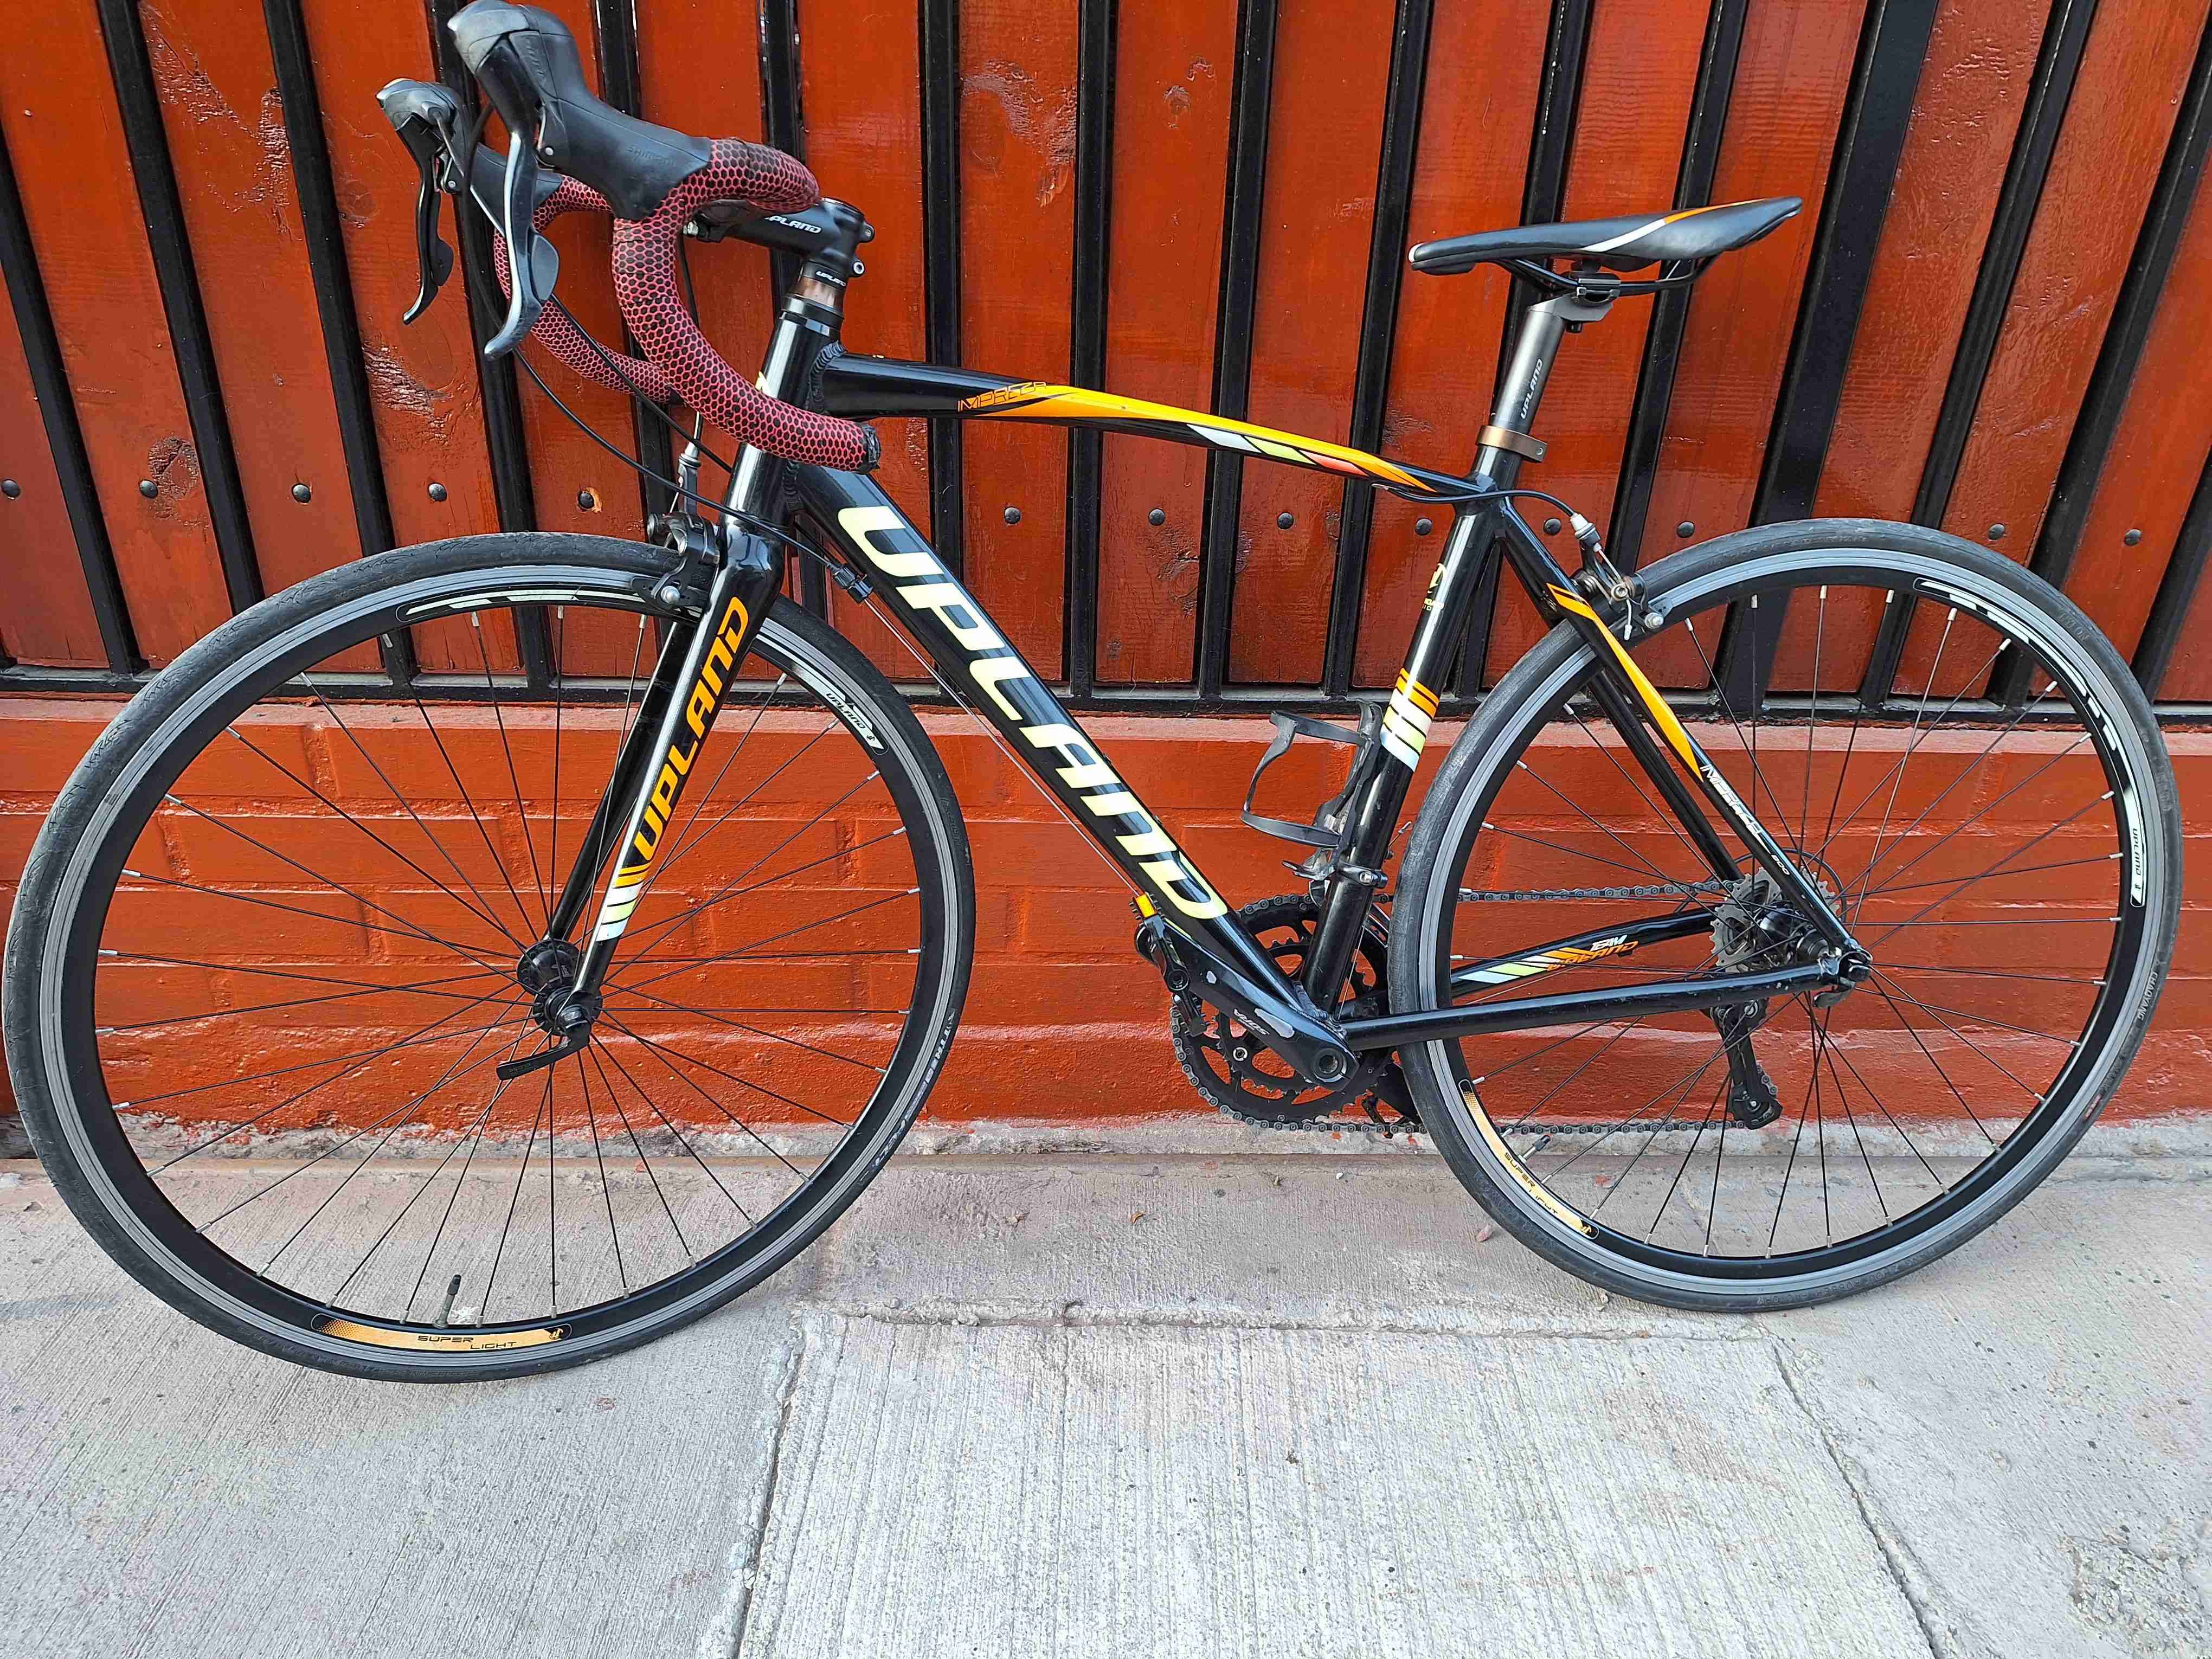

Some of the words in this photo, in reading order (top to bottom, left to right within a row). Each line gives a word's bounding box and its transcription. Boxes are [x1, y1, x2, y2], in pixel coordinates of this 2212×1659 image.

[764, 215, 822, 234] PLAND
[815, 270, 847, 287] UPLAND
[957, 381, 1048, 413] IMPREZA
[1520, 358, 1543, 420] UPLAND
[633, 596, 750, 862] UPLAND
[825, 692, 866, 730] UPLAND
[837, 505, 1229, 920] UPLAND
[2132, 828, 2142, 876] UPLAND
[1589, 934, 1628, 952] TEAM
[2137, 970, 2159, 1021] CHAOYANG
[1503, 1152, 1536, 1188] SUPER
[470, 1341, 517, 1349] LIGHT
